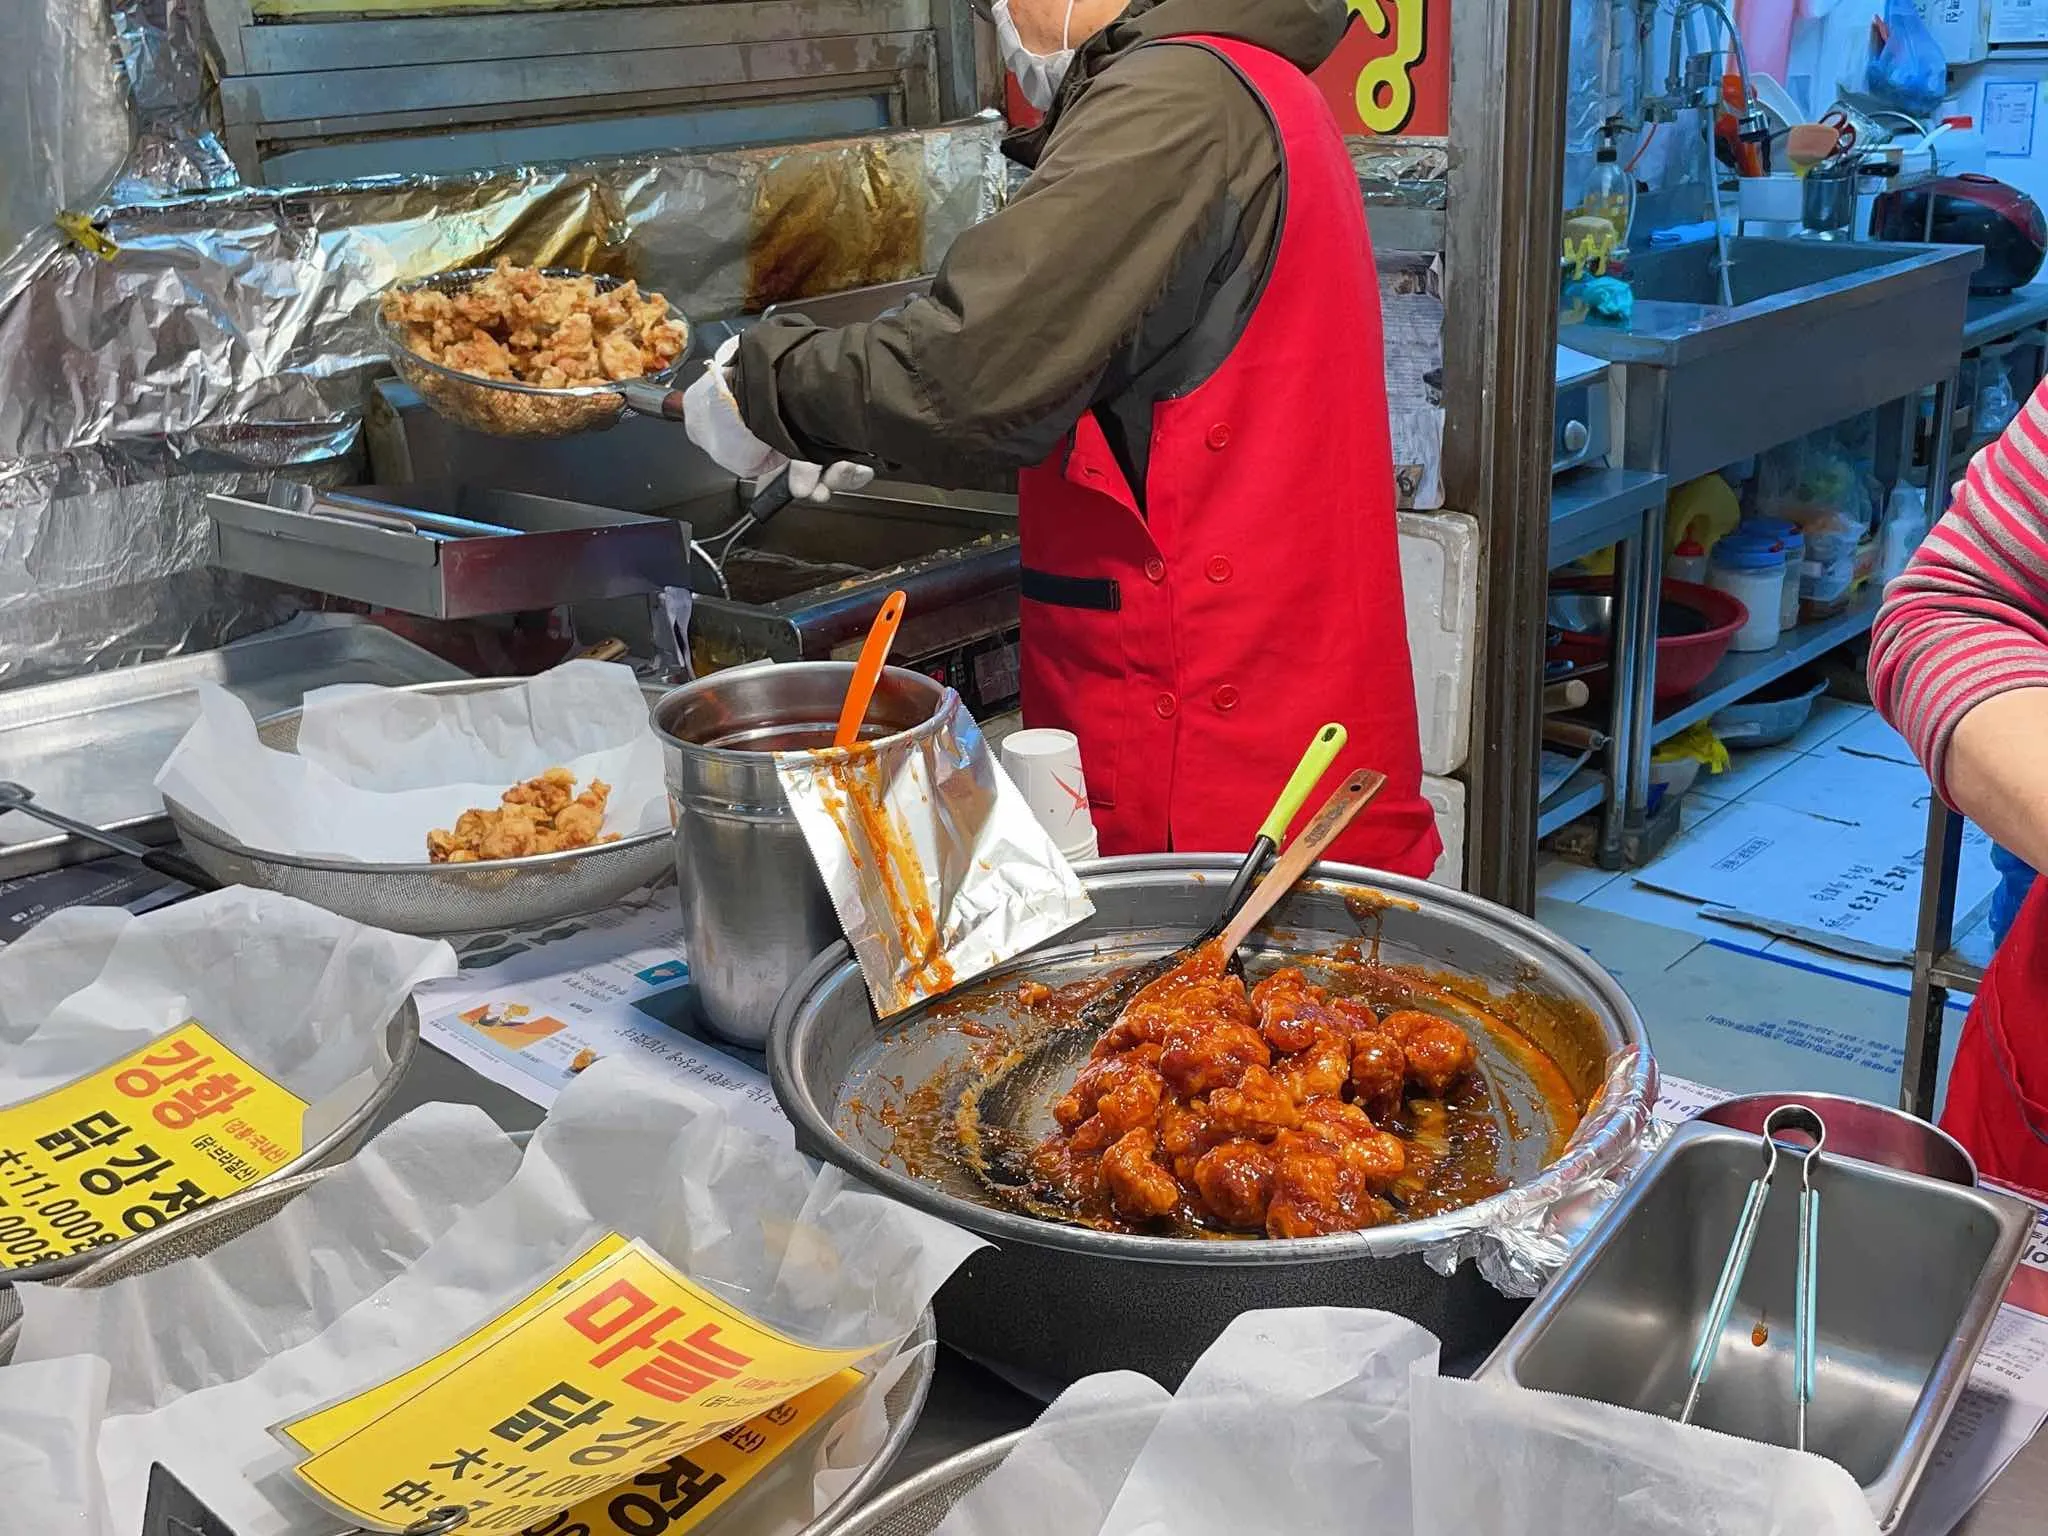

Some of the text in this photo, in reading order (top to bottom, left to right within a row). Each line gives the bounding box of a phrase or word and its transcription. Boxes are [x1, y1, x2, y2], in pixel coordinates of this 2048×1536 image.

[115, 1039, 256, 1130] 강황
[191, 1133, 260, 1183] (닭:브라질산)
[222, 1117, 291, 1164] (강황:국내산)
[563, 1278, 754, 1402] 마늘
